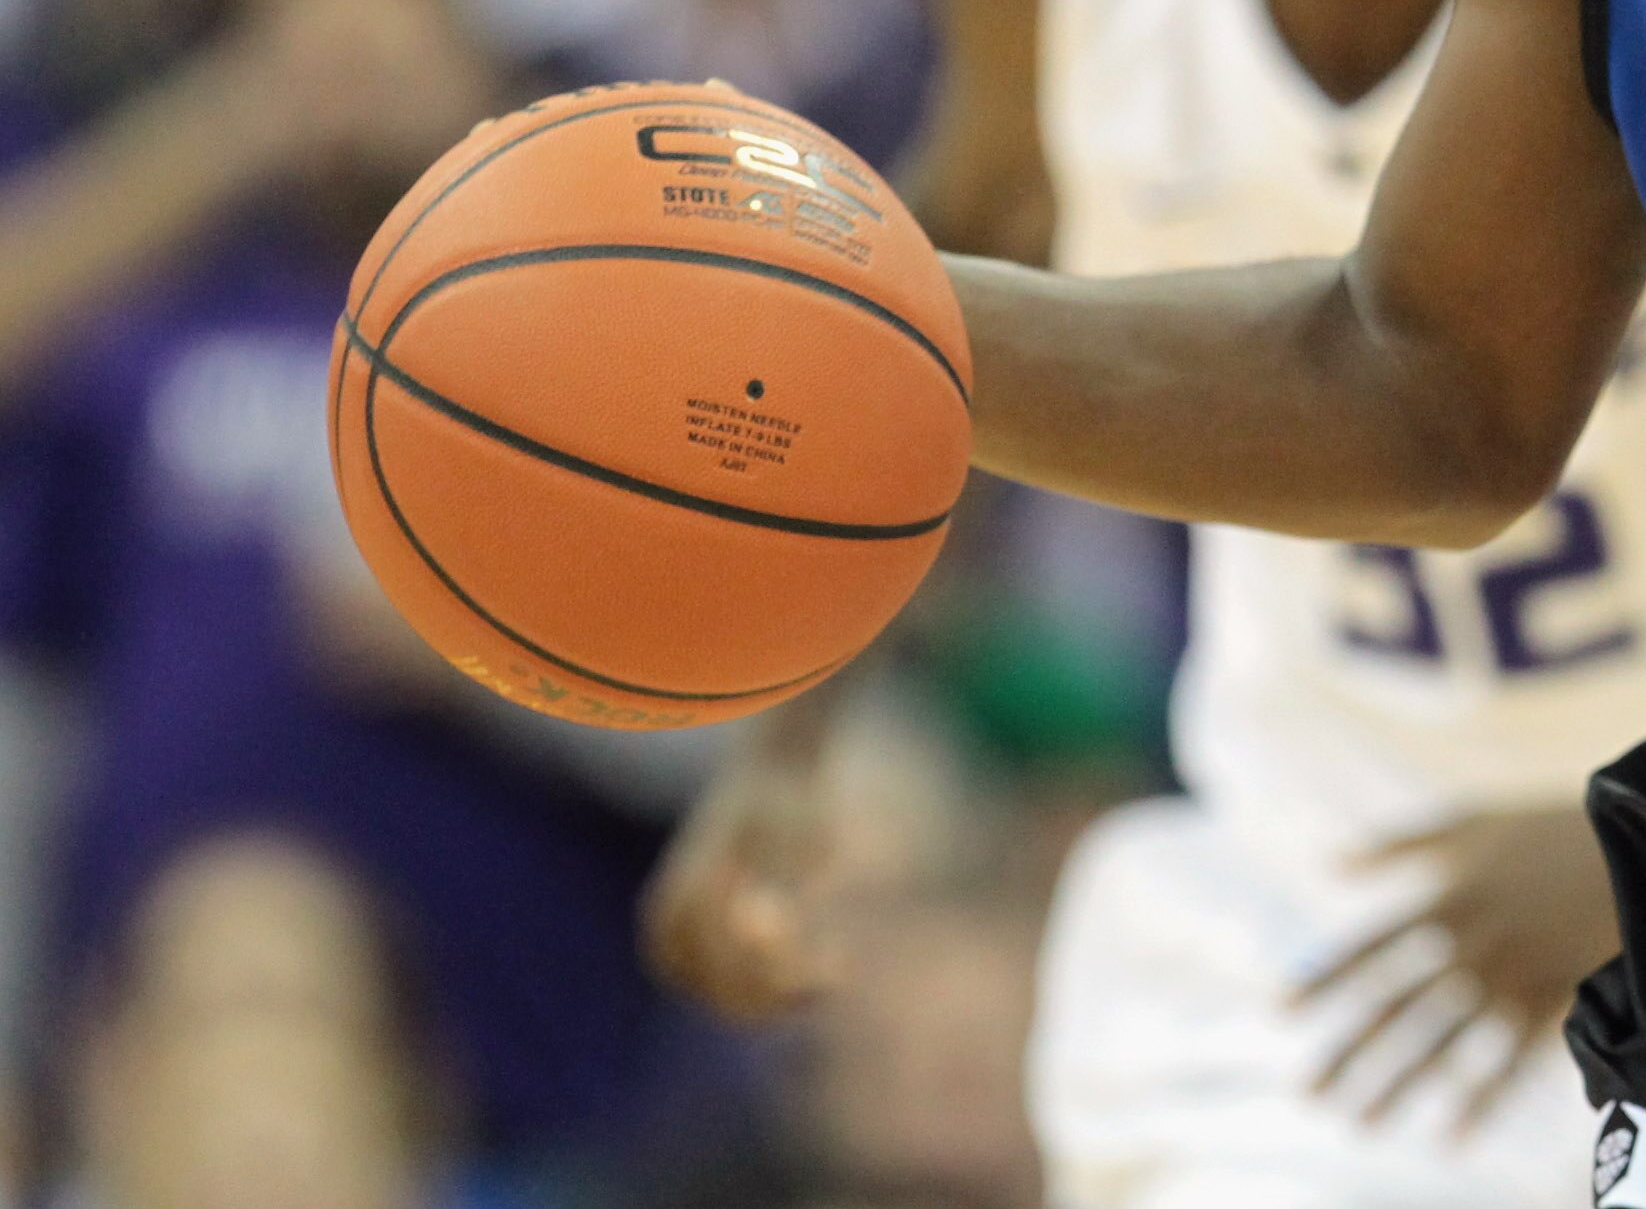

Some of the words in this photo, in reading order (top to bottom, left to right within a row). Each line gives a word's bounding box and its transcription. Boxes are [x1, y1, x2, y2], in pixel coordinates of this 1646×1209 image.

[686, 415, 741, 436] INFLATE
[687, 399, 747, 420] MOISTEN
[750, 413, 801, 433] NEEDLE
[688, 432, 726, 450] MADE
[729, 442, 742, 453] IN
[745, 446, 785, 464] CHINA
